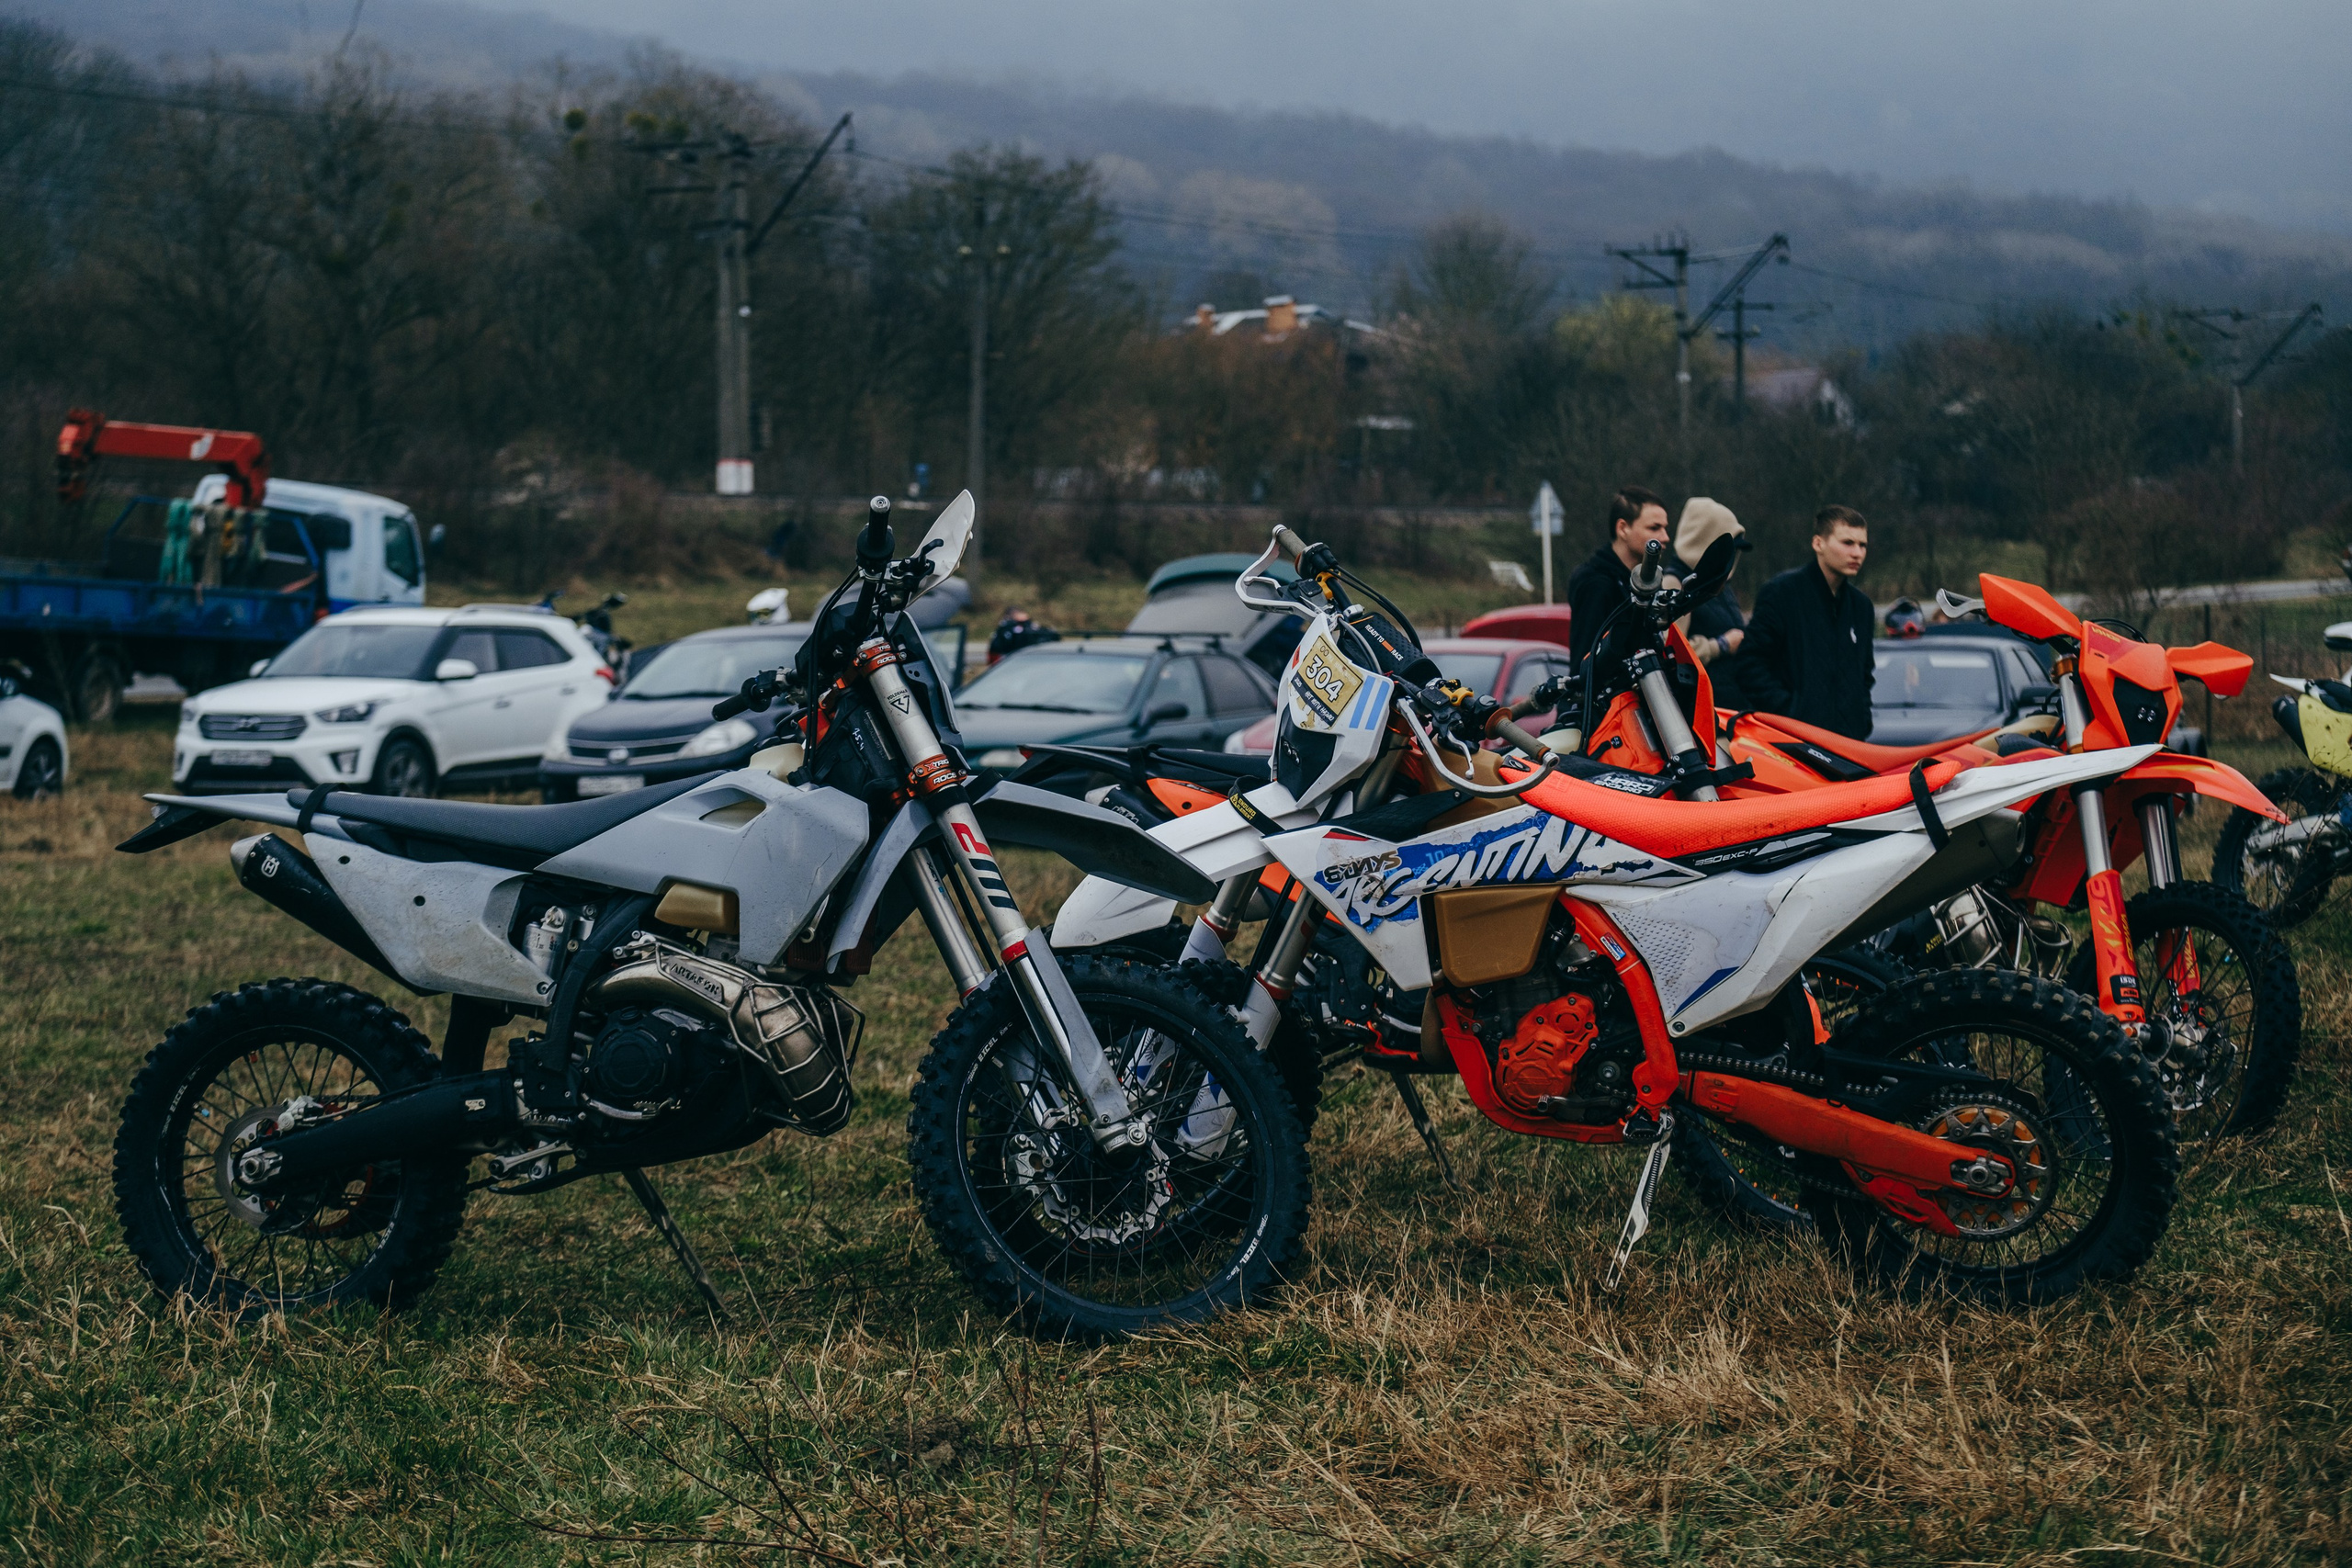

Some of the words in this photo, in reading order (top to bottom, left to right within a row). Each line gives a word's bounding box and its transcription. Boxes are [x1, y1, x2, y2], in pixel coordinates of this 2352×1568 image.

[1364, 624, 1380, 638] READY
[1376, 635, 1385, 643] TO
[1391, 649, 1404, 661] RACE
[876, 655, 897, 665] ROCS
[1306, 653, 1344, 703] 304
[924, 758, 950, 771] XTRIG
[933, 773, 957, 784] ROCS
[1593, 780, 1644, 794] ENDURO
[1603, 776, 1655, 792] HARD
[978, 1036, 999, 1063] EXCEL
[169, 1085, 188, 1113] EXCEL
[1238, 1237, 1260, 1264] EXCEL
